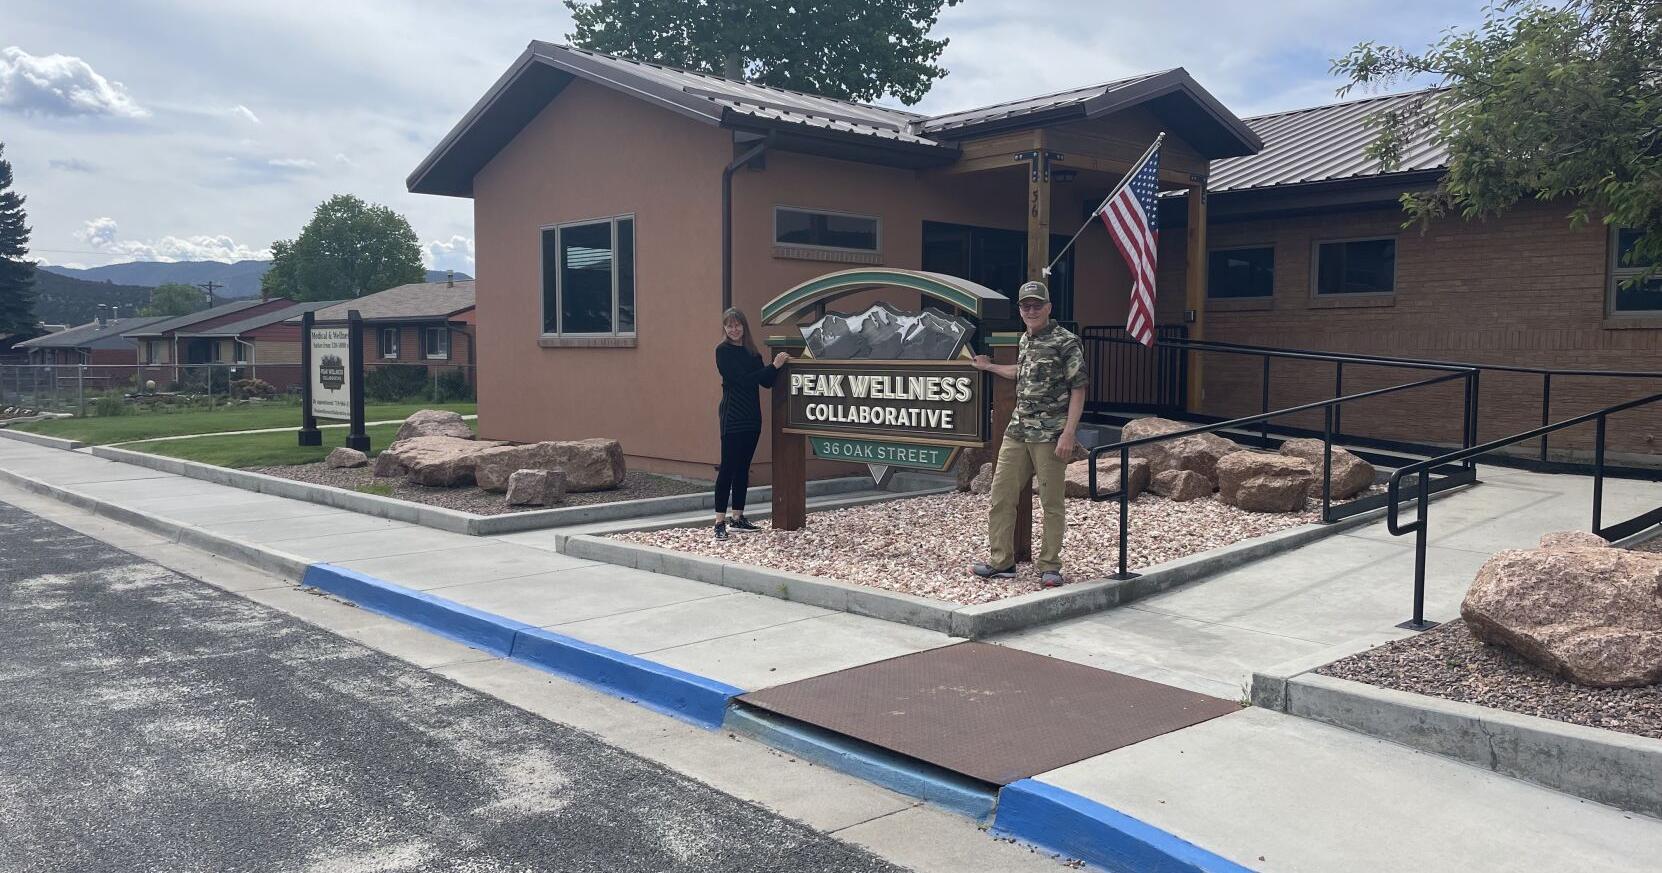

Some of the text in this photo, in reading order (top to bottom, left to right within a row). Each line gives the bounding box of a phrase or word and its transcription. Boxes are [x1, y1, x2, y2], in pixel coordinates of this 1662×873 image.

[312, 331, 327, 339] Medical
[333, 331, 347, 339] Wellne
[791, 374, 972, 402] PEAK WELLNESS
[806, 403, 954, 429] COLLABORATIVE
[823, 442, 939, 464] 36 OAK STREET
